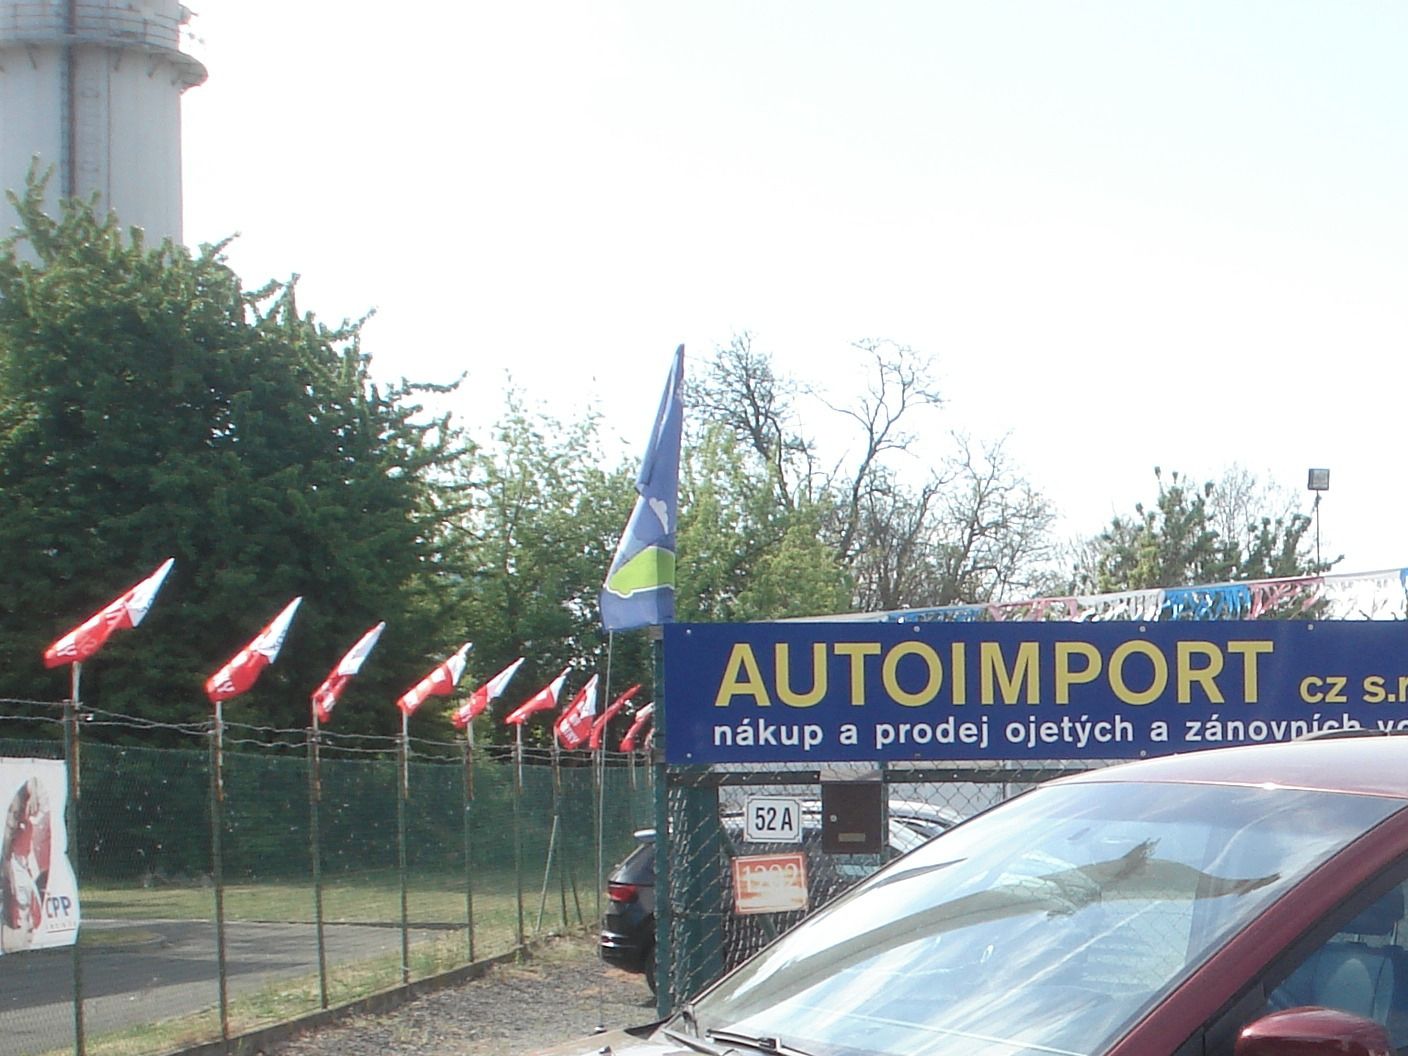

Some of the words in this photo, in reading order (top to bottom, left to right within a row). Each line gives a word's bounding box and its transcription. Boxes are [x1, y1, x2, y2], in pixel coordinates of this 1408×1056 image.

[714, 641, 1274, 707] AUTOIMPORT
[1299, 676, 1347, 704] cz
[713, 715, 824, 750] nákup
[839, 724, 858, 747] a
[875, 716, 990, 750] prodej
[1006, 713, 1135, 749] ojetých
[1150, 721, 1169, 744] a
